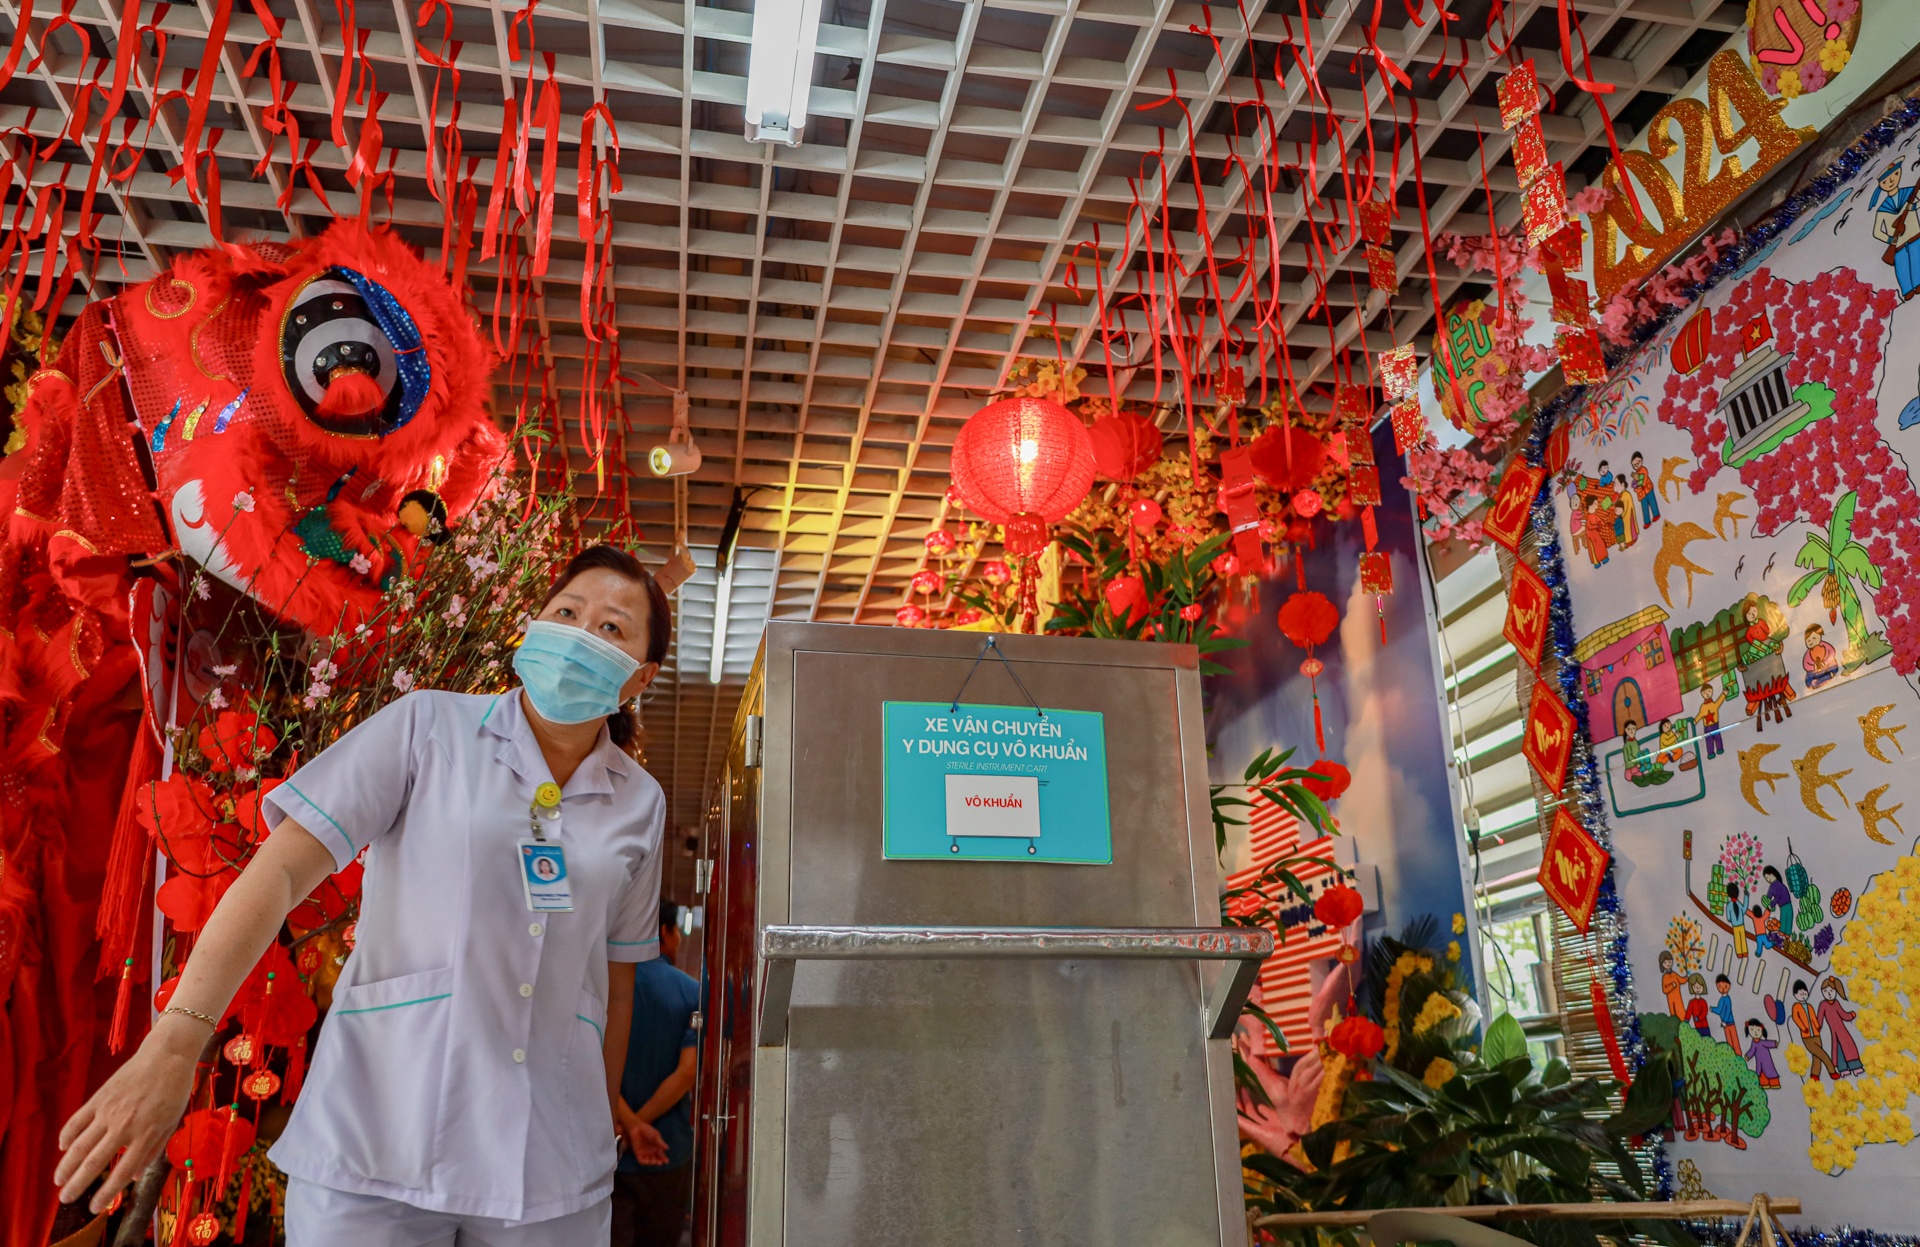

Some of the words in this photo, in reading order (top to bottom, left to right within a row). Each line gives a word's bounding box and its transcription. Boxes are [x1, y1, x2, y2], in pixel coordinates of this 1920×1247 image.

[1580, 48, 1820, 314] 2024
[925, 717, 948, 732] XE
[952, 715, 988, 737] VẬN
[992, 715, 1062, 738] CHUYỂN
[902, 739, 914, 753] Y
[919, 740, 970, 758] DỤNG
[973, 741, 997, 759] CỤ
[1001, 739, 1027, 757] VÔ
[1030, 738, 1088, 761] KHUẨN
[946, 761, 975, 771] STERILE
[976, 763, 1025, 772] INSTRUMENT
[1026, 764, 1048, 773] CART
[965, 795, 982, 807] VÔ
[983, 794, 1023, 809] KHUẨN
[233, 1040, 252, 1060] 福
[195, 1219, 213, 1240] 福
